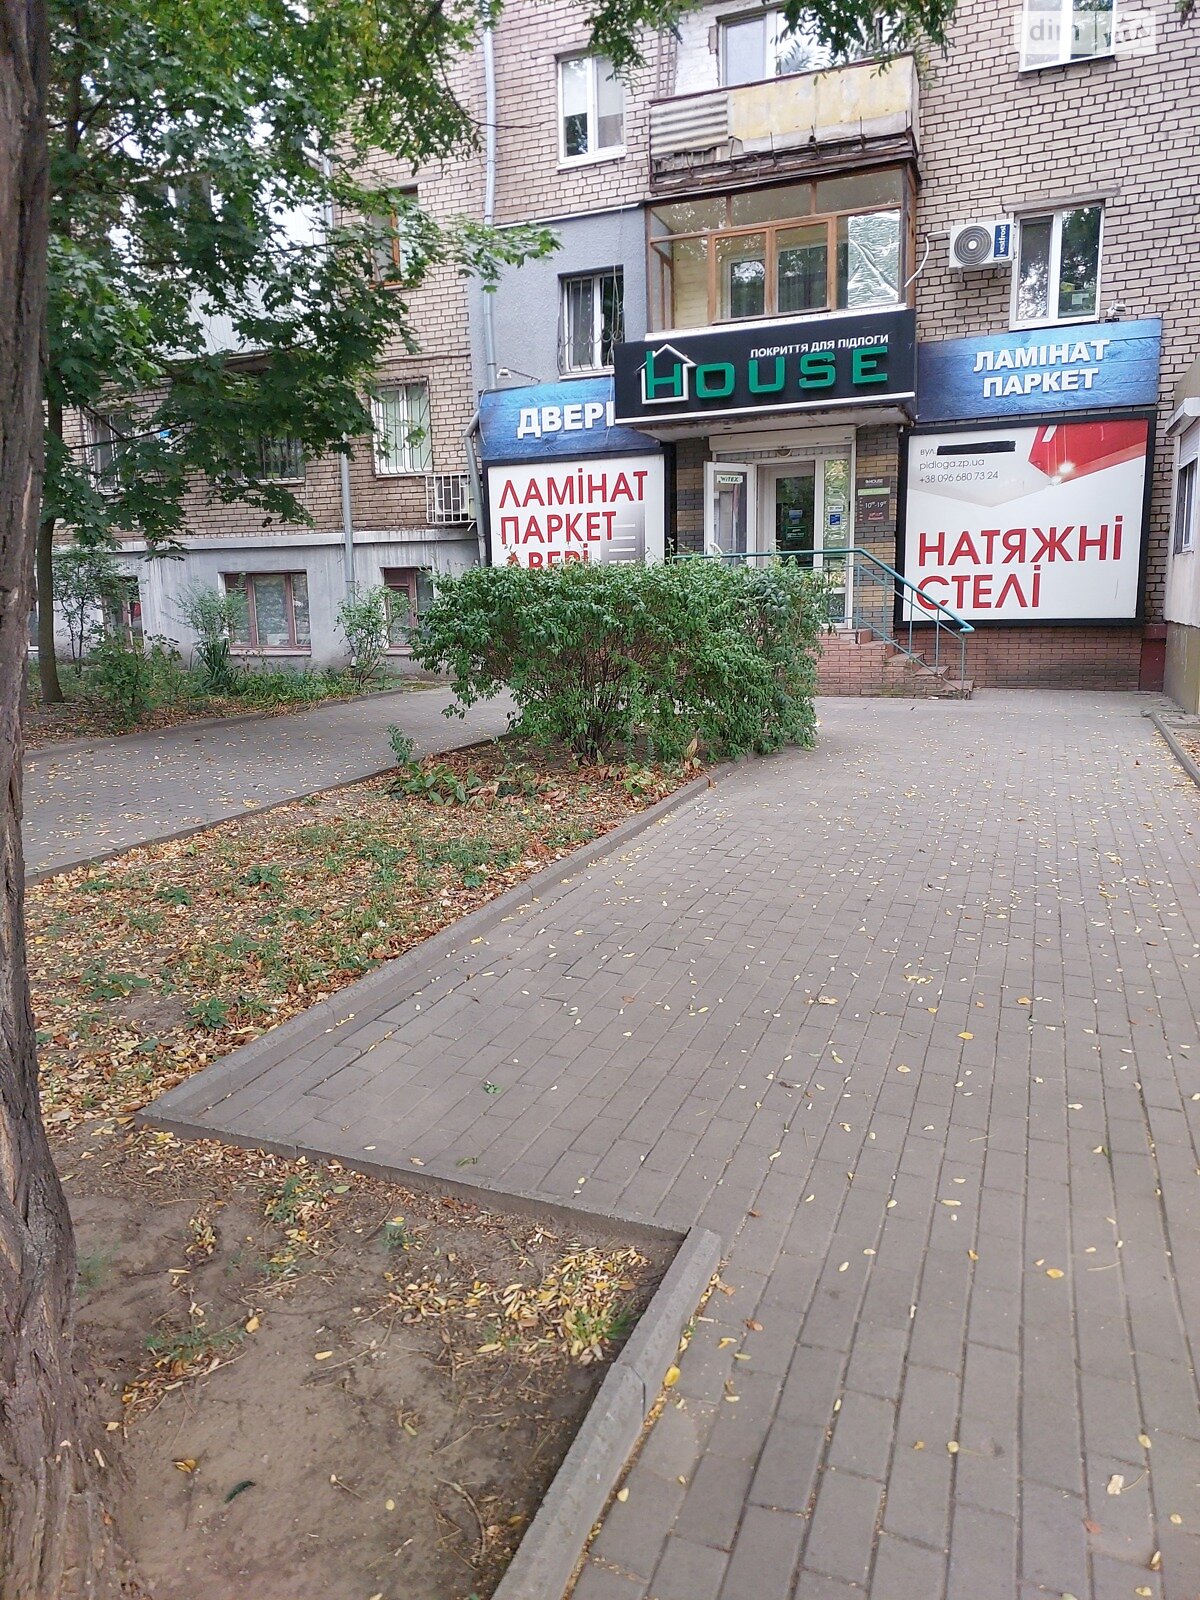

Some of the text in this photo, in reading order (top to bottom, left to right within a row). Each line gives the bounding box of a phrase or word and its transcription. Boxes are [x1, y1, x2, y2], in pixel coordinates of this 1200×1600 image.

[750, 334, 889, 359] ПОКРИТТЯ ДЛЯ ПІДЛОГИ
[973, 339, 1110, 373] ЛАМІНАТ
[645, 345, 888, 399] HOUSE
[983, 367, 1099, 398] ПАРКЕТ
[516, 400, 615, 440] ДВЕРІ
[919, 458, 985, 471] pidloga.zp.ua
[919, 470, 998, 484] +38 096 680 73 24
[500, 510, 617, 545] ПАРКЕТ
